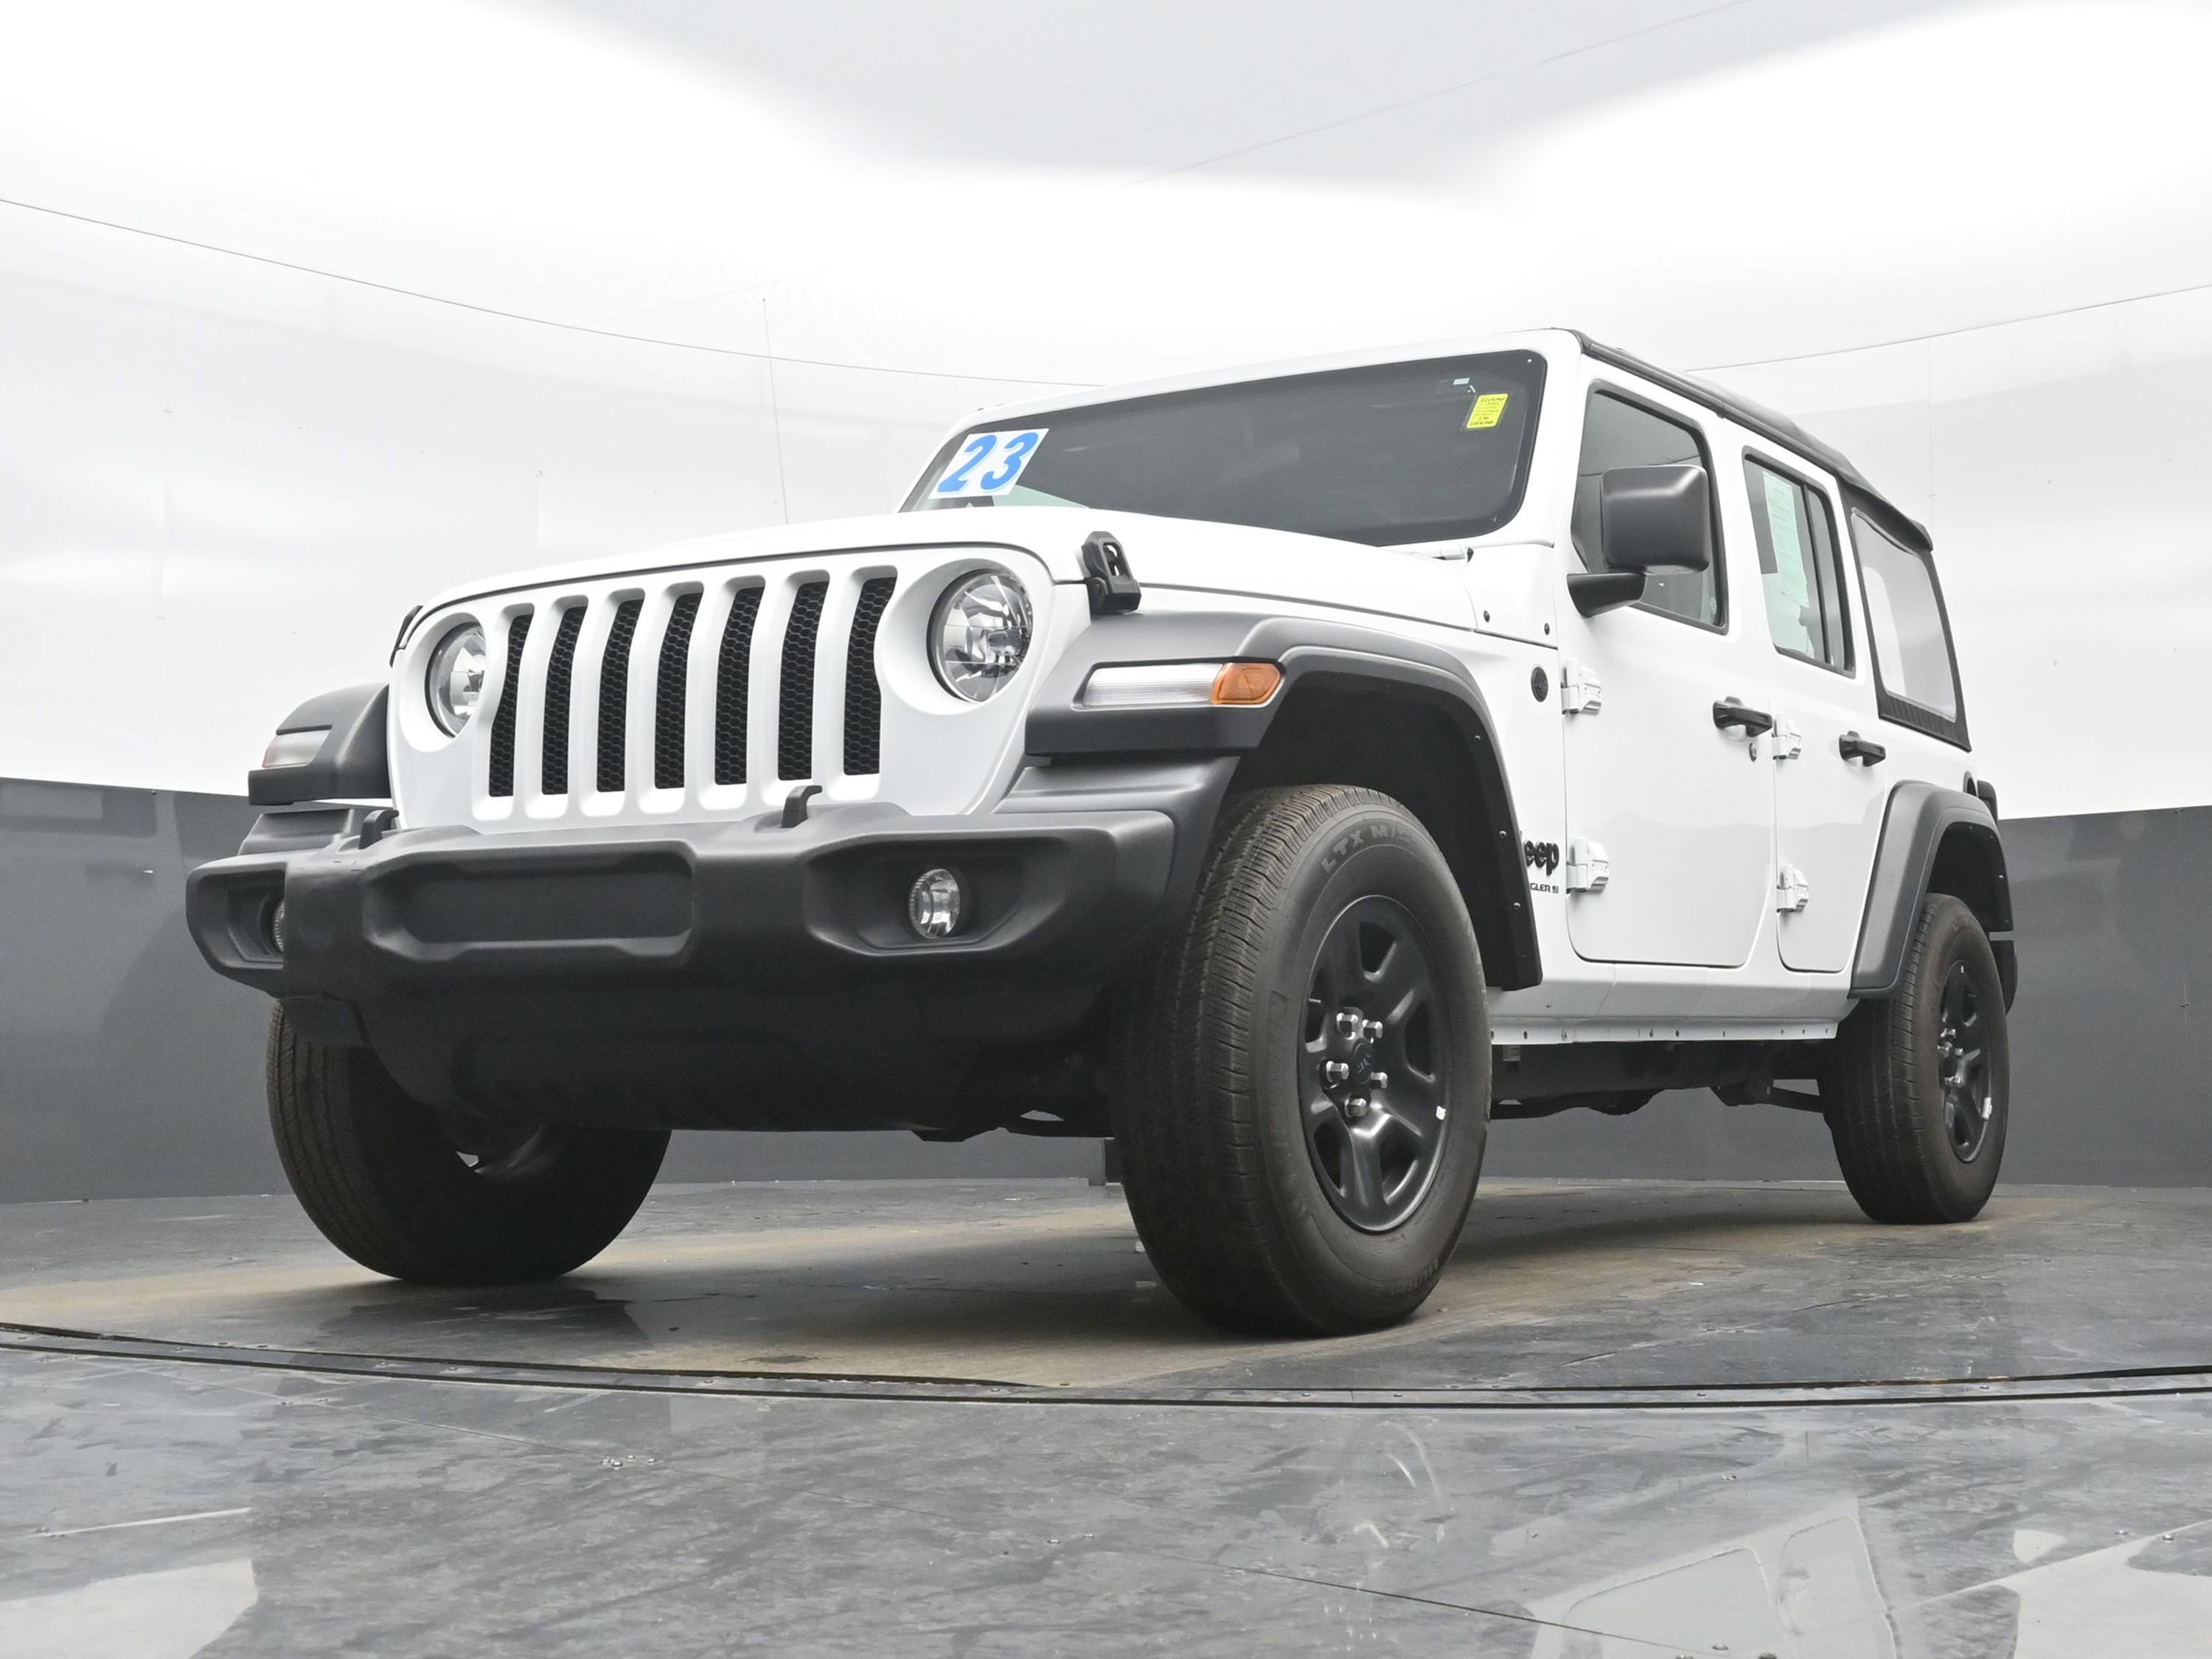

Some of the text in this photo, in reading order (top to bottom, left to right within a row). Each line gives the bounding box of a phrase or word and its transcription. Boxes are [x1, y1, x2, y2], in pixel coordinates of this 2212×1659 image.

[936, 431, 1039, 493] 23
[1321, 829, 1365, 874] LTX
[1522, 839, 1559, 877] eep
[1530, 883, 1551, 893] GLER
